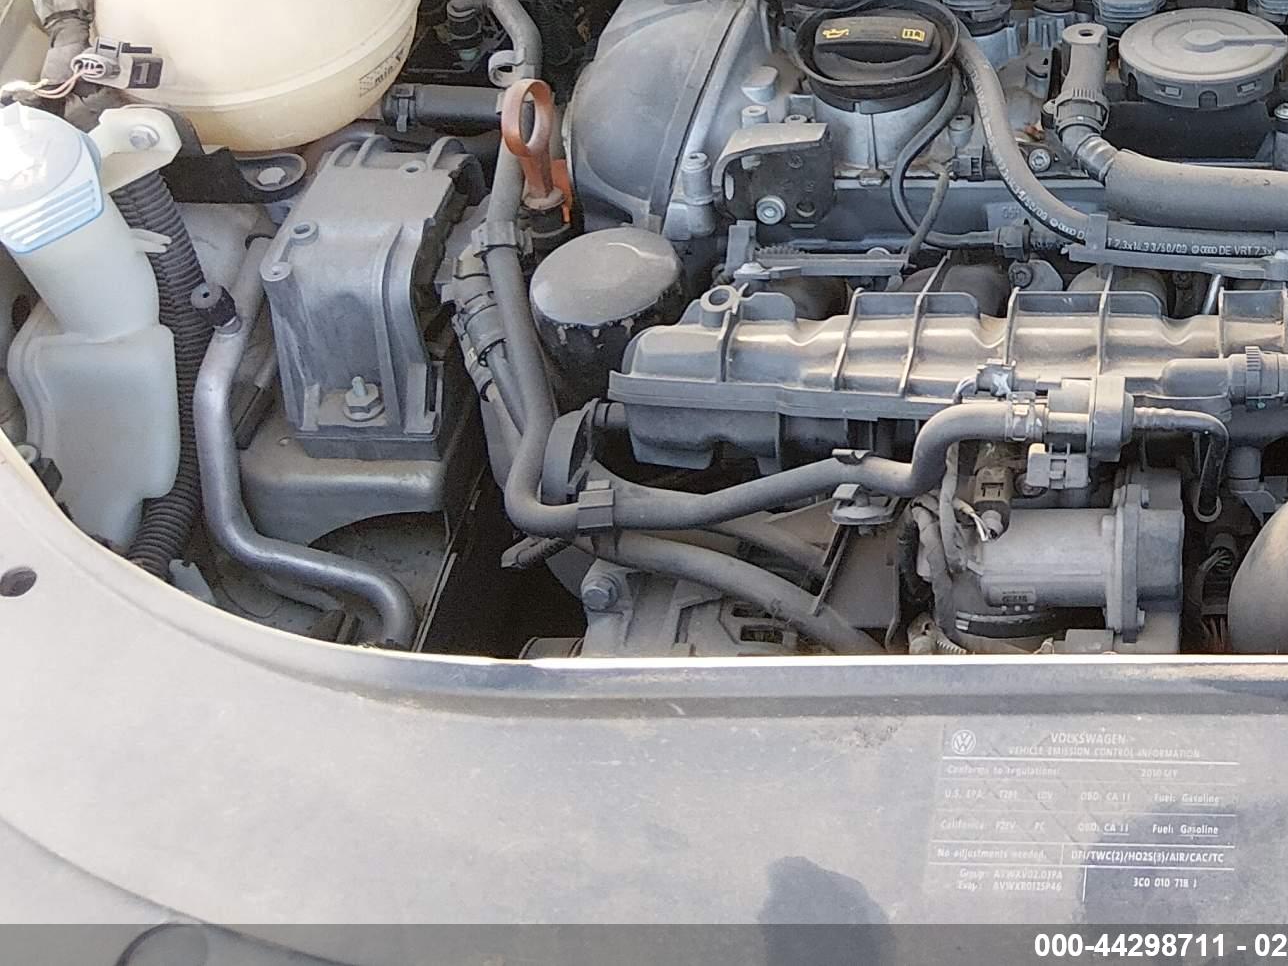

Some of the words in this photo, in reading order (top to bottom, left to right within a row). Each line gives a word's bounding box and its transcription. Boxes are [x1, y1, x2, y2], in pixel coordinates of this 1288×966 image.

[1219, 244, 1231, 255] DE
[1051, 733, 1126, 745] VOLKSWAGEN
[1182, 793, 1220, 804] Gasoline
[1104, 823, 1117, 833] CA
[1152, 824, 1174, 835] Fuel:
[1180, 824, 1219, 835] Gasoline
[1154, 877, 1170, 888] 010
